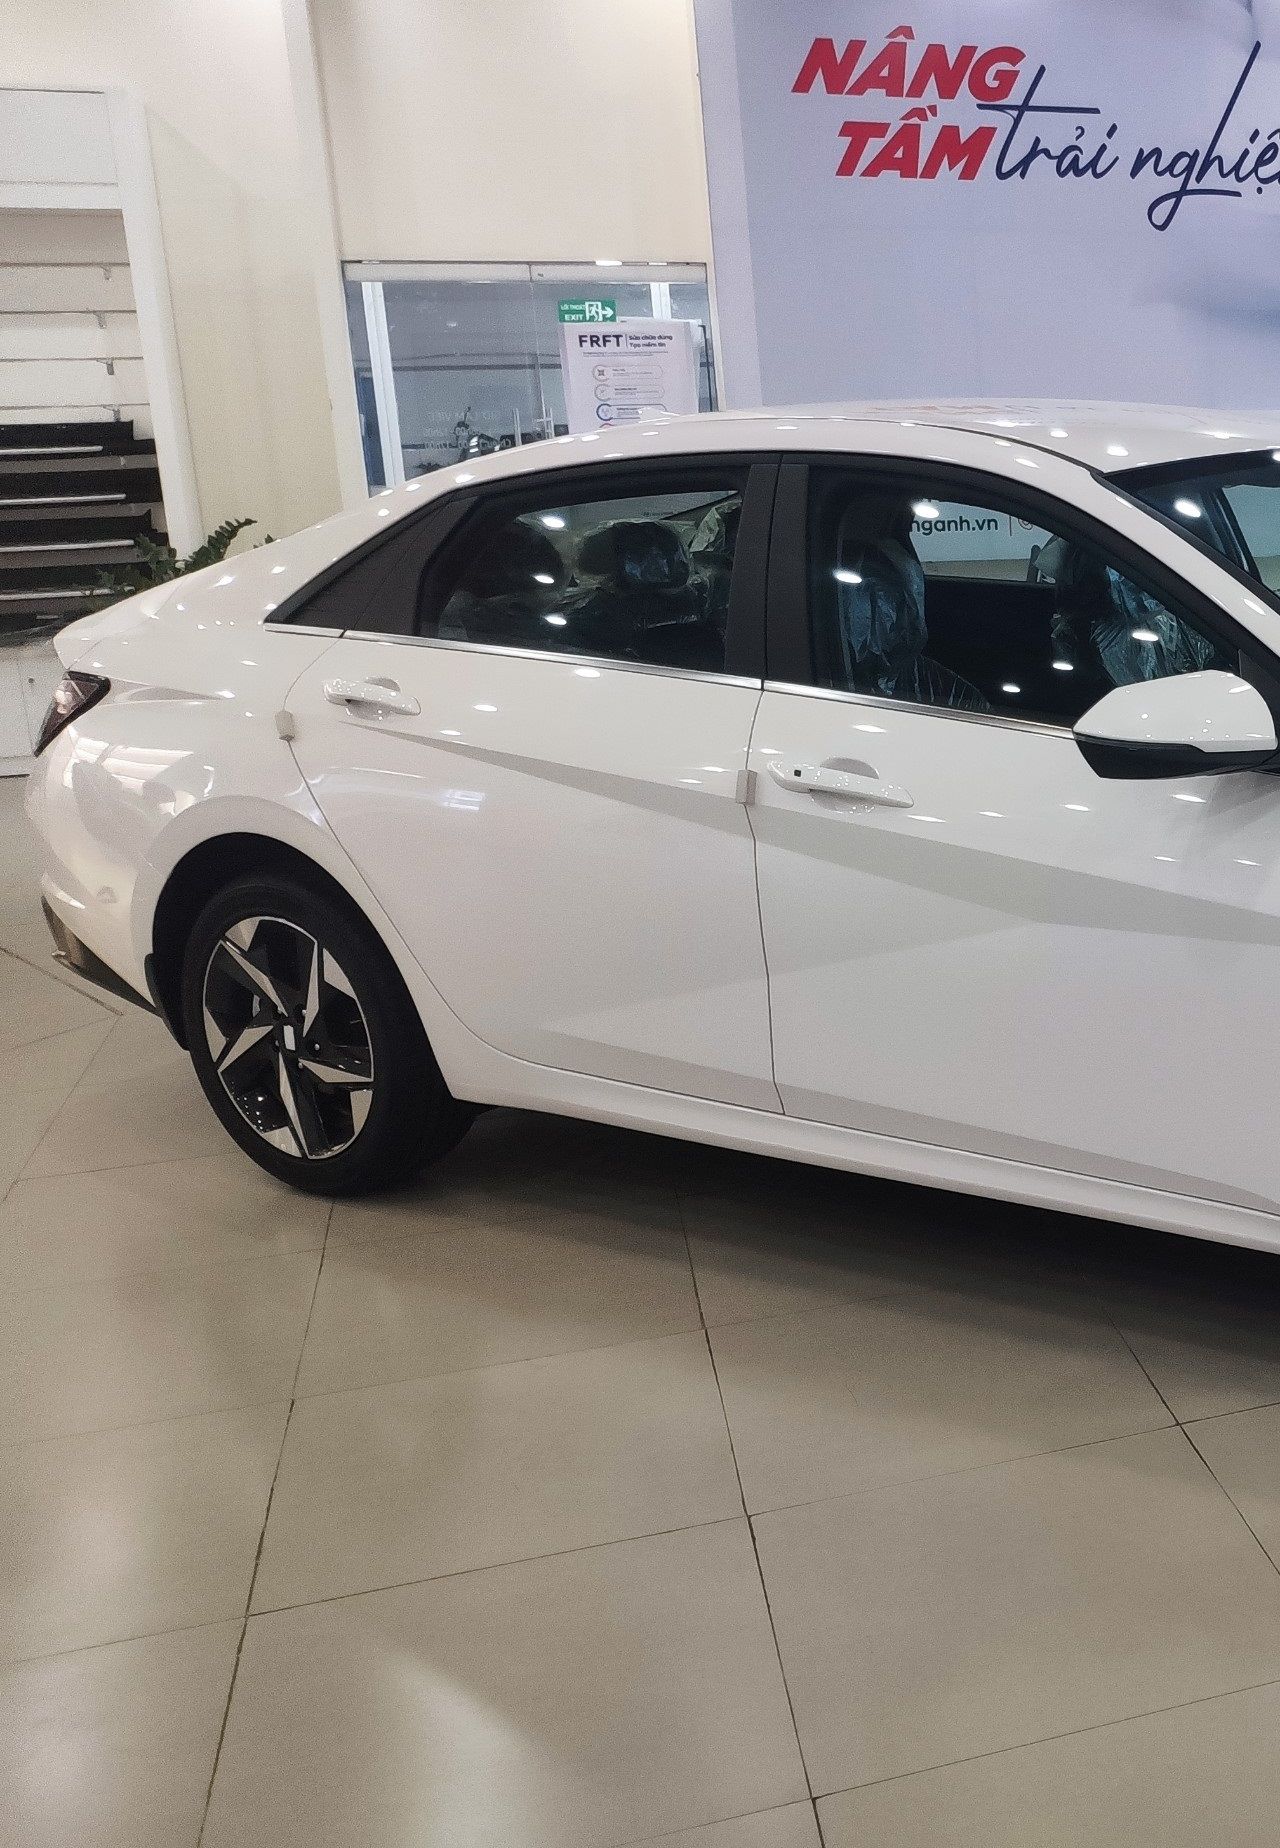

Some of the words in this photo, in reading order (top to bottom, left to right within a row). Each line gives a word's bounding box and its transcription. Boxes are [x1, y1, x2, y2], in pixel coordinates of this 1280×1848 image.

[791, 25, 1027, 102] NÂNG
[835, 104, 997, 181] TẦM
[976, 64, 1119, 181] trải
[564, 313, 584, 321] EXIT
[578, 334, 623, 348] FRFT
